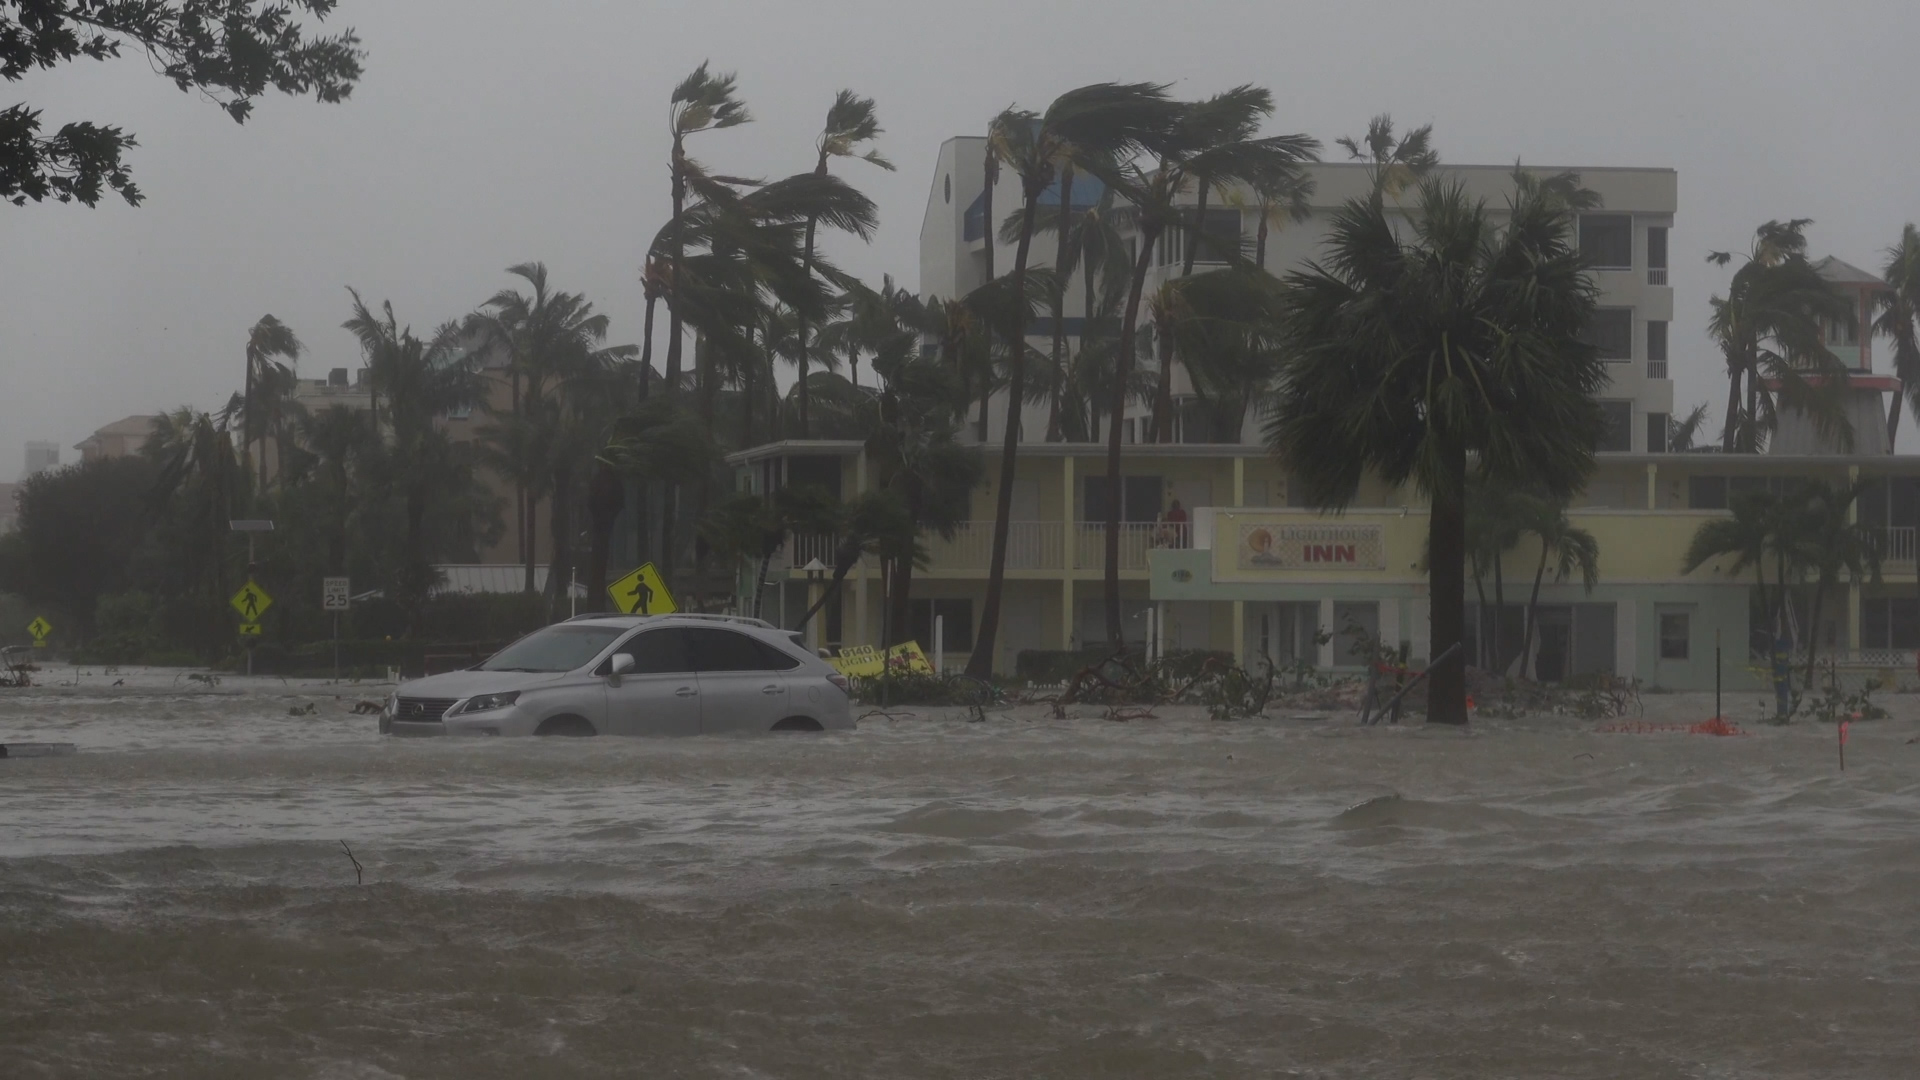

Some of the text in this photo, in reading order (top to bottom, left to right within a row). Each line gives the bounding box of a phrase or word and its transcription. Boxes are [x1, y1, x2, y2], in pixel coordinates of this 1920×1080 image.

[1282, 529, 1378, 541] LIGHTHOUSE
[1303, 545, 1355, 562] INN
[325, 594, 347, 606] 25
[842, 646, 872, 657] 9140
